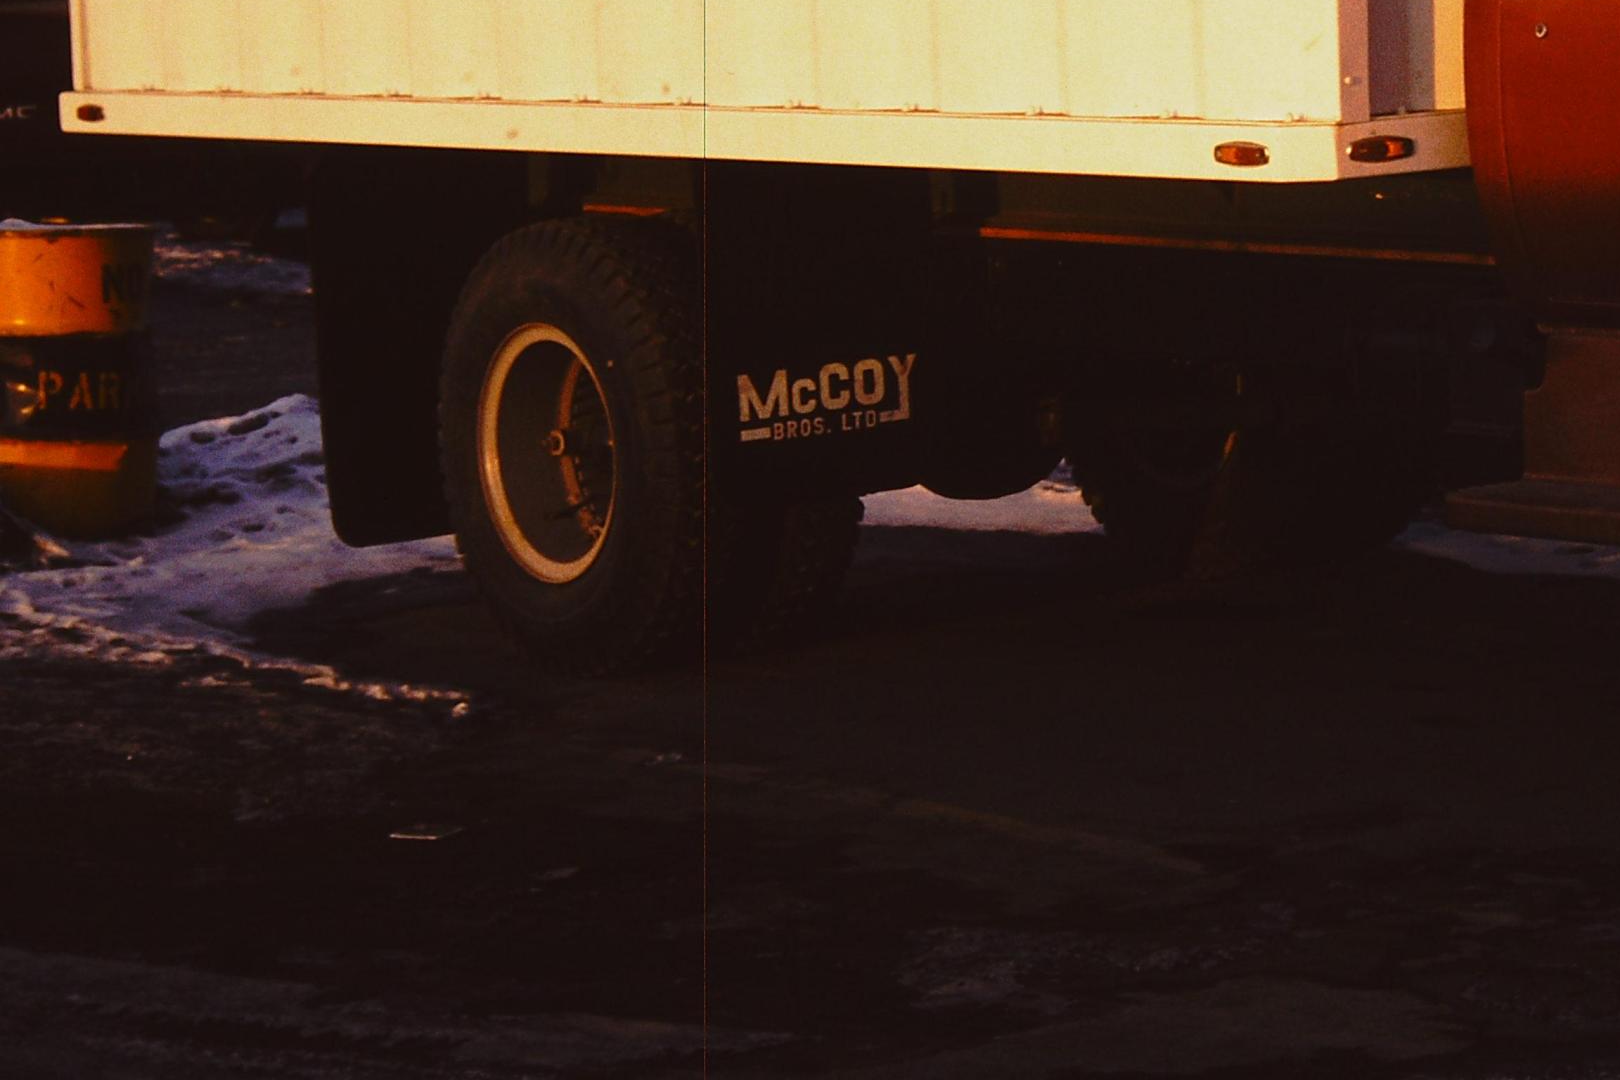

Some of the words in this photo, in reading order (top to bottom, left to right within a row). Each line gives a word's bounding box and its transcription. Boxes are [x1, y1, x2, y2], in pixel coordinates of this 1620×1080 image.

[36, 368, 126, 411] PAR
[737, 353, 916, 422] McCOY
[772, 417, 833, 441] BROS.
[840, 409, 877, 431] LTD
